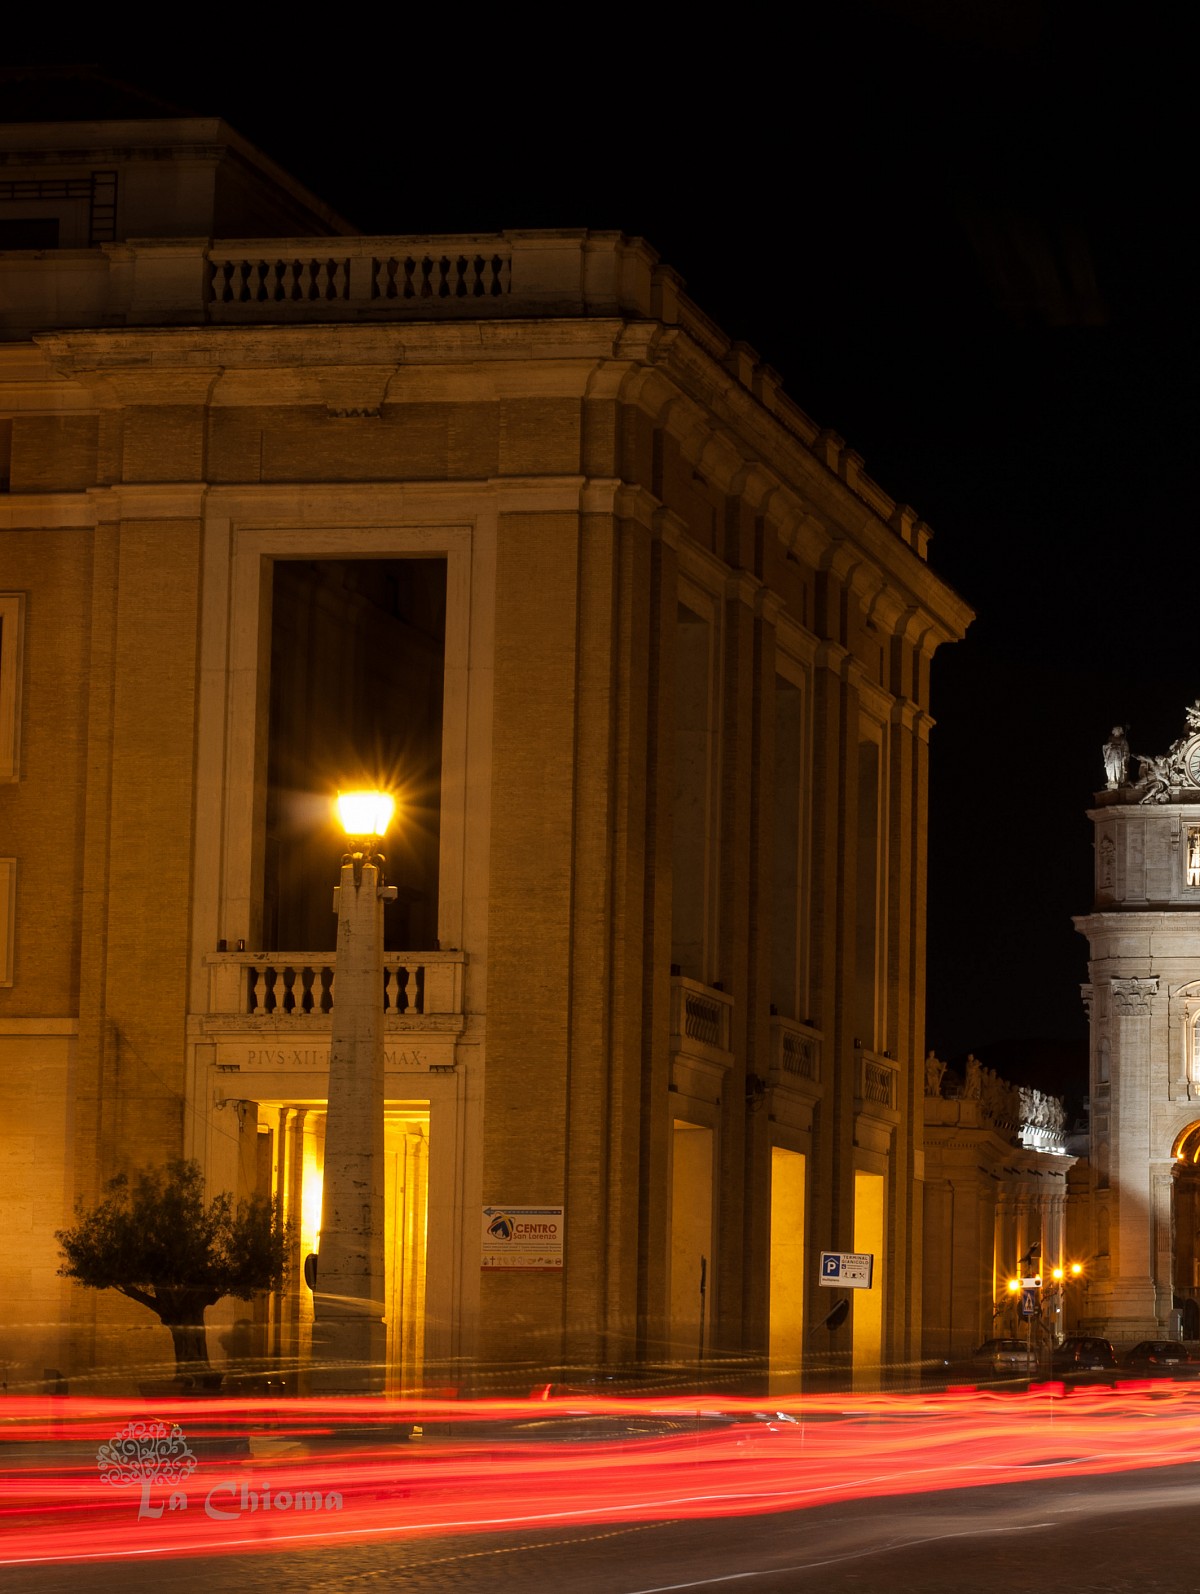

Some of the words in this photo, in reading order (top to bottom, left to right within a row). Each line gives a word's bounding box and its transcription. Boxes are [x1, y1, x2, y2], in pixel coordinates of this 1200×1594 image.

[248, 1050, 285, 1065] PIVS
[293, 1050, 316, 1065] XII
[515, 1223, 557, 1234] CENTRO
[513, 1232, 527, 1240] San
[528, 1232, 557, 1240] Lorenzo
[826, 1261, 837, 1274] P
